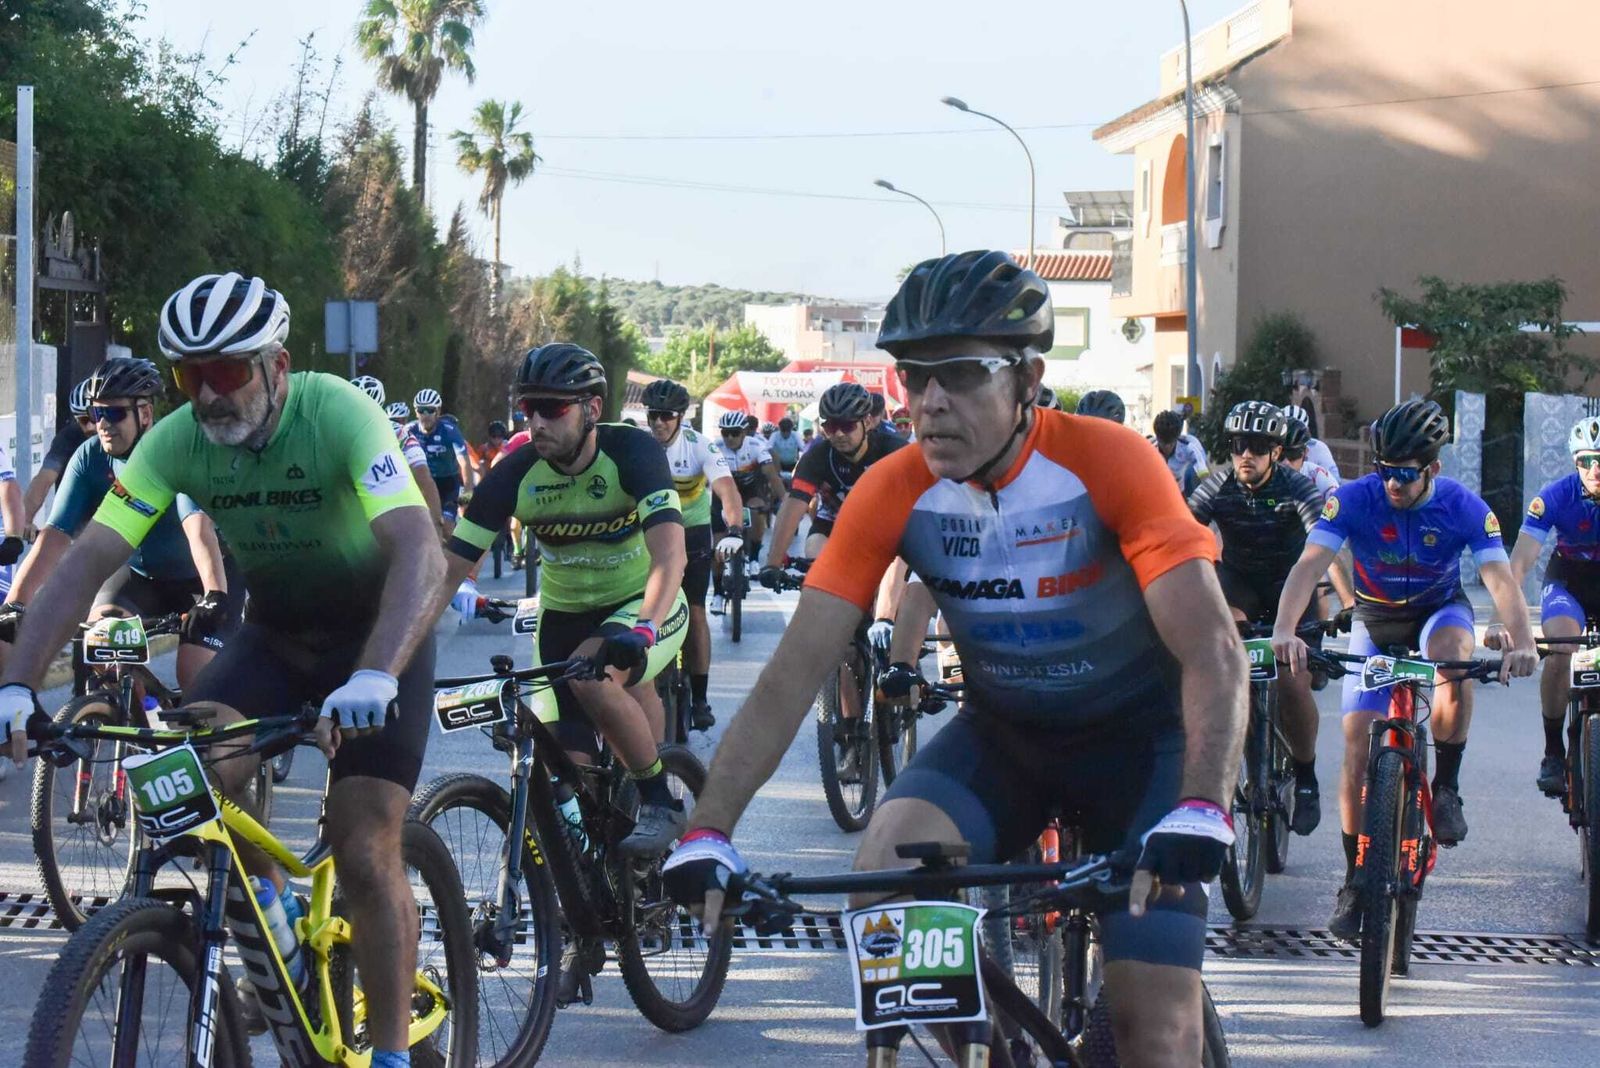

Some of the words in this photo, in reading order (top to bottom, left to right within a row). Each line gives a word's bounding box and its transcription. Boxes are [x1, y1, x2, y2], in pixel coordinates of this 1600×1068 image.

[763, 376, 815, 388] TOYOTA
[113, 628, 141, 645] 419
[658, 609, 686, 638] FUNDIDOS
[140, 767, 195, 807] 105
[905, 927, 965, 970] 305
